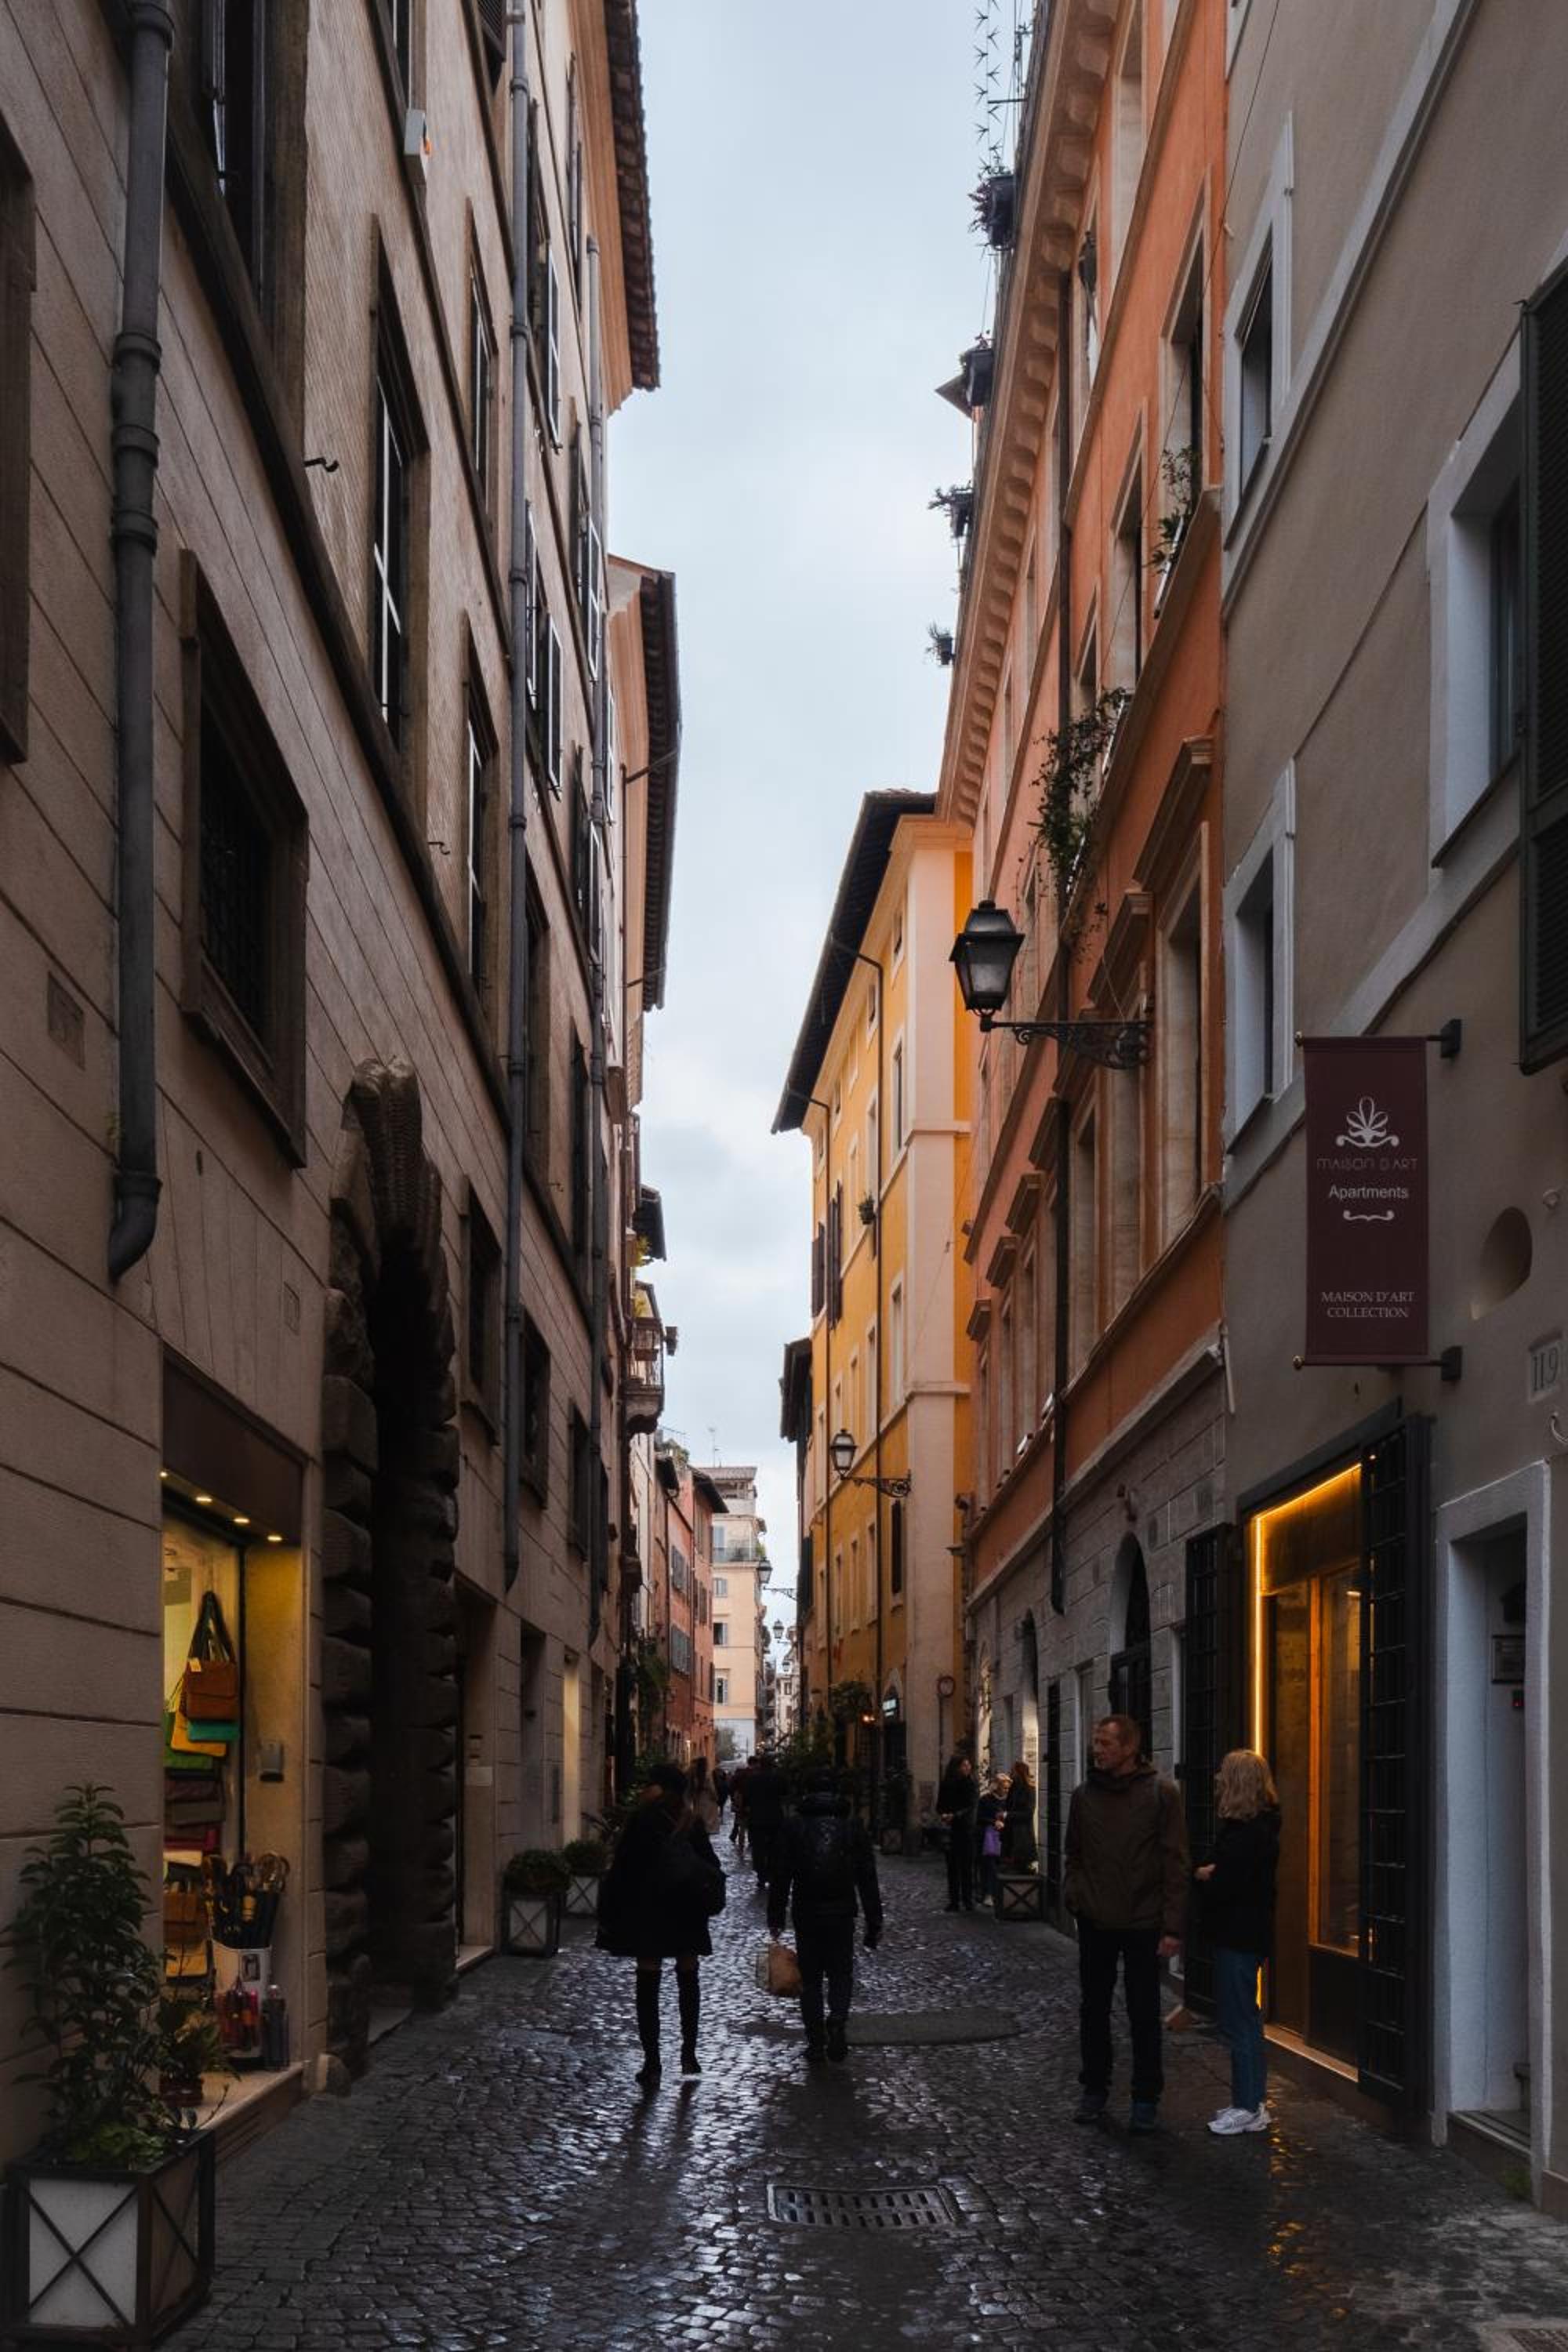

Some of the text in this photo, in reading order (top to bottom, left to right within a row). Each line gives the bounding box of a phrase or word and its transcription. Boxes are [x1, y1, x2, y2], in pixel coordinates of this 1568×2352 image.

[1329, 1184, 1410, 1201] Apartments
[1321, 1291, 1415, 1302] MAISON D'ART
[1327, 1307, 1410, 1318] COLLECTION
[1533, 1348, 1559, 1392] 119
